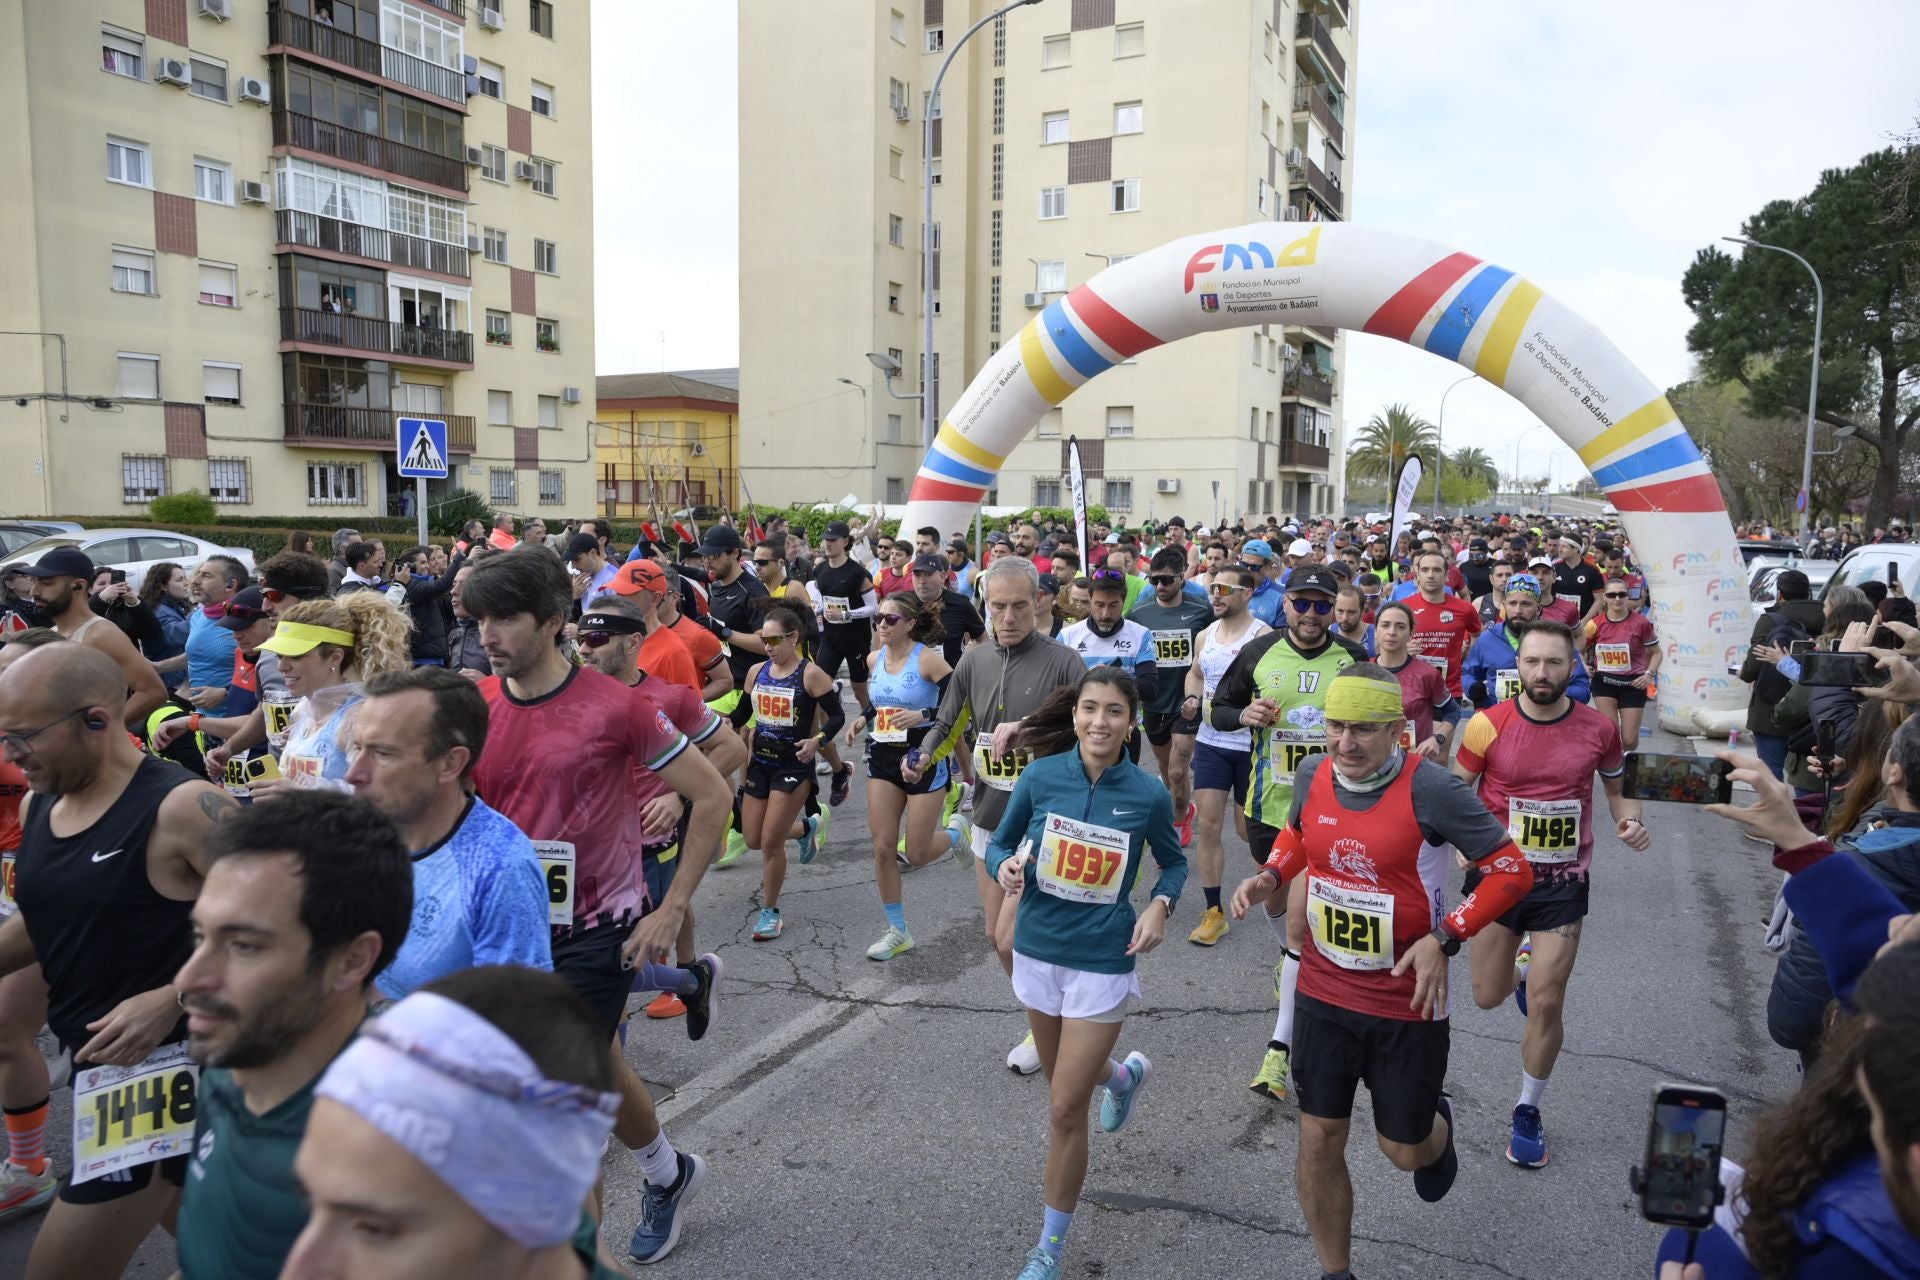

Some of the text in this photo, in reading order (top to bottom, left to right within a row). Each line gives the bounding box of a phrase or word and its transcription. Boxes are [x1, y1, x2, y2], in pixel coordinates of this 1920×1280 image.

[1223, 277, 1300, 289] Fundación Municipal
[1224, 291, 1272, 300] de Deportes
[1227, 303, 1277, 314] Ayuntamiento
[1290, 300, 1318, 309] Badajoz
[1533, 332, 1609, 404] Fundación Municipal
[1524, 342, 1613, 428] de Deportes de Badajoz
[962, 361, 1022, 434] de Deportes de Badajoz
[588, 617, 605, 625] FILA
[1113, 639, 1132, 649] ACS
[1156, 639, 1189, 658] 1569
[1601, 651, 1628, 664] 1940
[1298, 670, 1320, 693] 17
[757, 694, 790, 718] 1962
[1522, 815, 1576, 847] 1492
[1056, 839, 1123, 886] 1937
[1324, 905, 1381, 953] 1221
[96, 1070, 198, 1147] 1448
